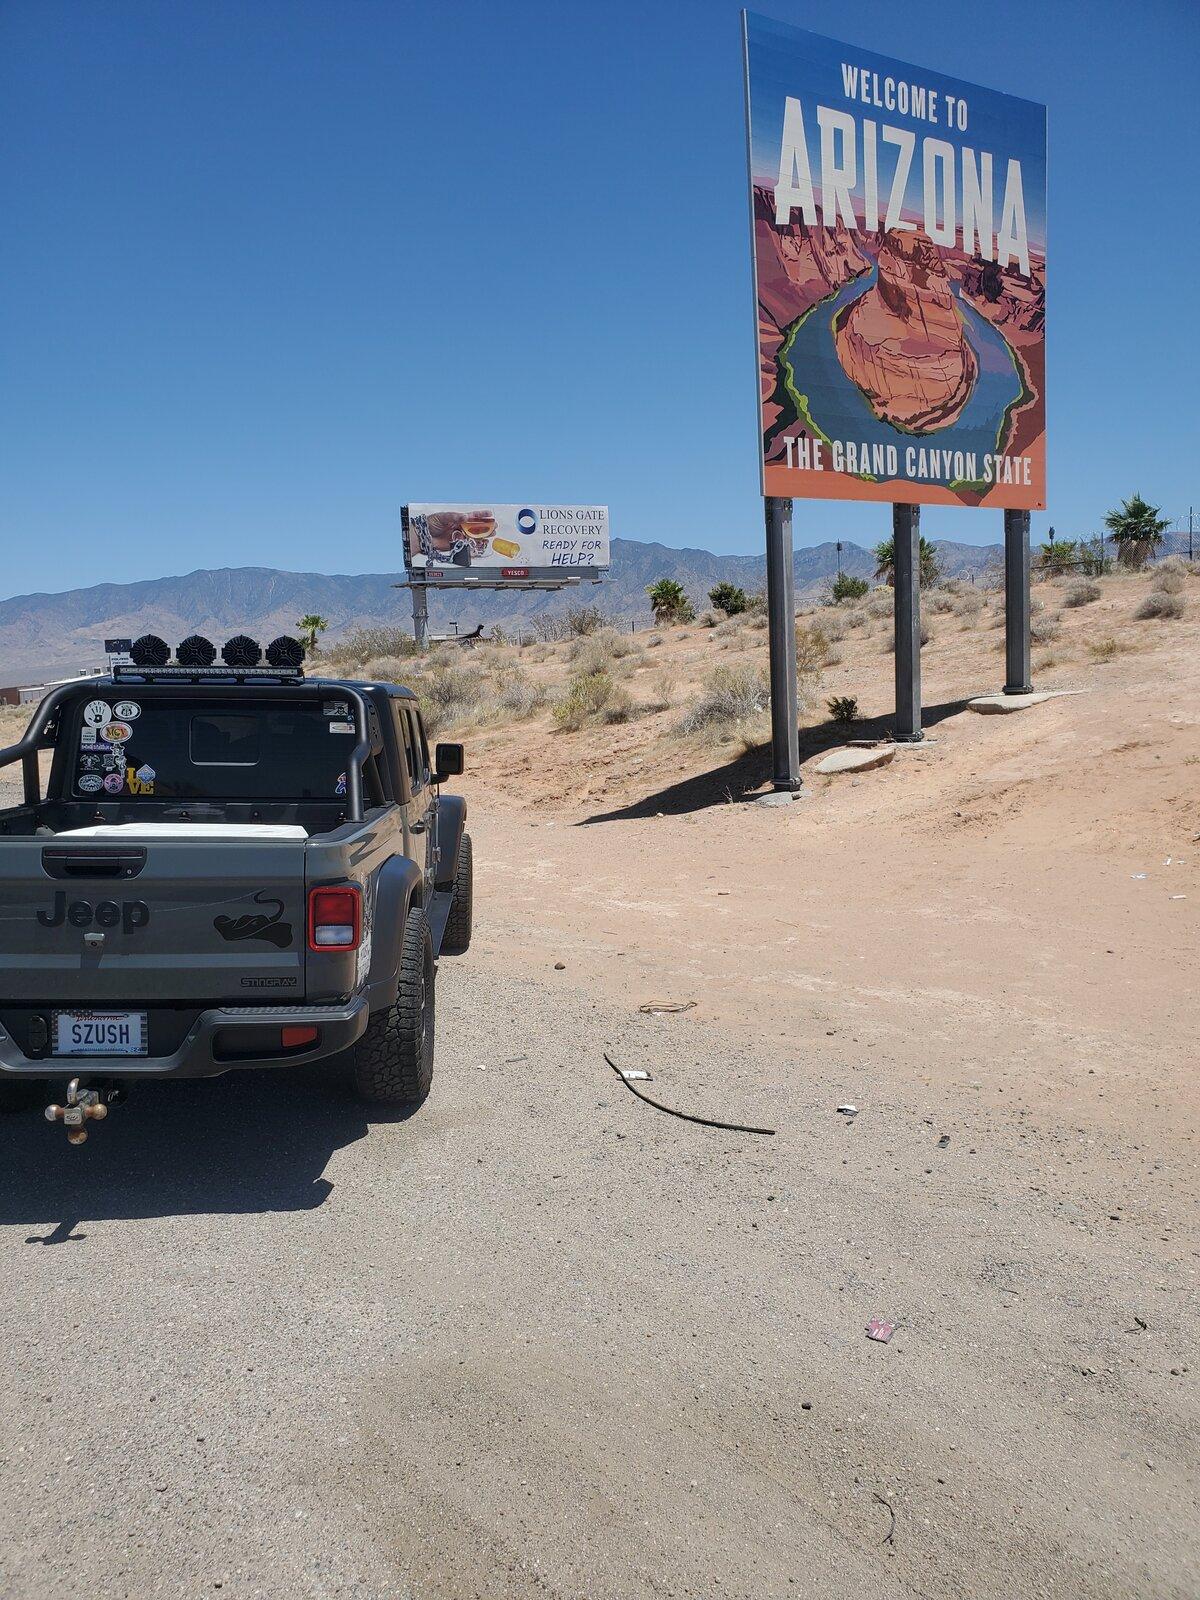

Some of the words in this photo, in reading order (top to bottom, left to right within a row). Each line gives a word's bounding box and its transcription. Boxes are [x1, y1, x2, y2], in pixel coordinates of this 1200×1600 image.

[841, 62, 938, 124] WELCOME
[945, 95, 968, 132] TO
[773, 96, 1031, 278] ARIZONA
[783, 435, 824, 471] THE
[831, 439, 898, 476] GRAND
[905, 446, 977, 482] CANYON
[982, 453, 1032, 486] STATE
[540, 509, 573, 520] LIONS
[576, 510, 605, 521] GATE
[543, 524, 603, 535] RECOVERY
[542, 540, 577, 550] READY
[581, 540, 601, 550] FOR
[551, 552, 595, 565] HELP?
[36, 890, 150, 934] Jeep
[241, 977, 297, 988] STINGRAY
[72, 1024, 130, 1044] SZUSH
